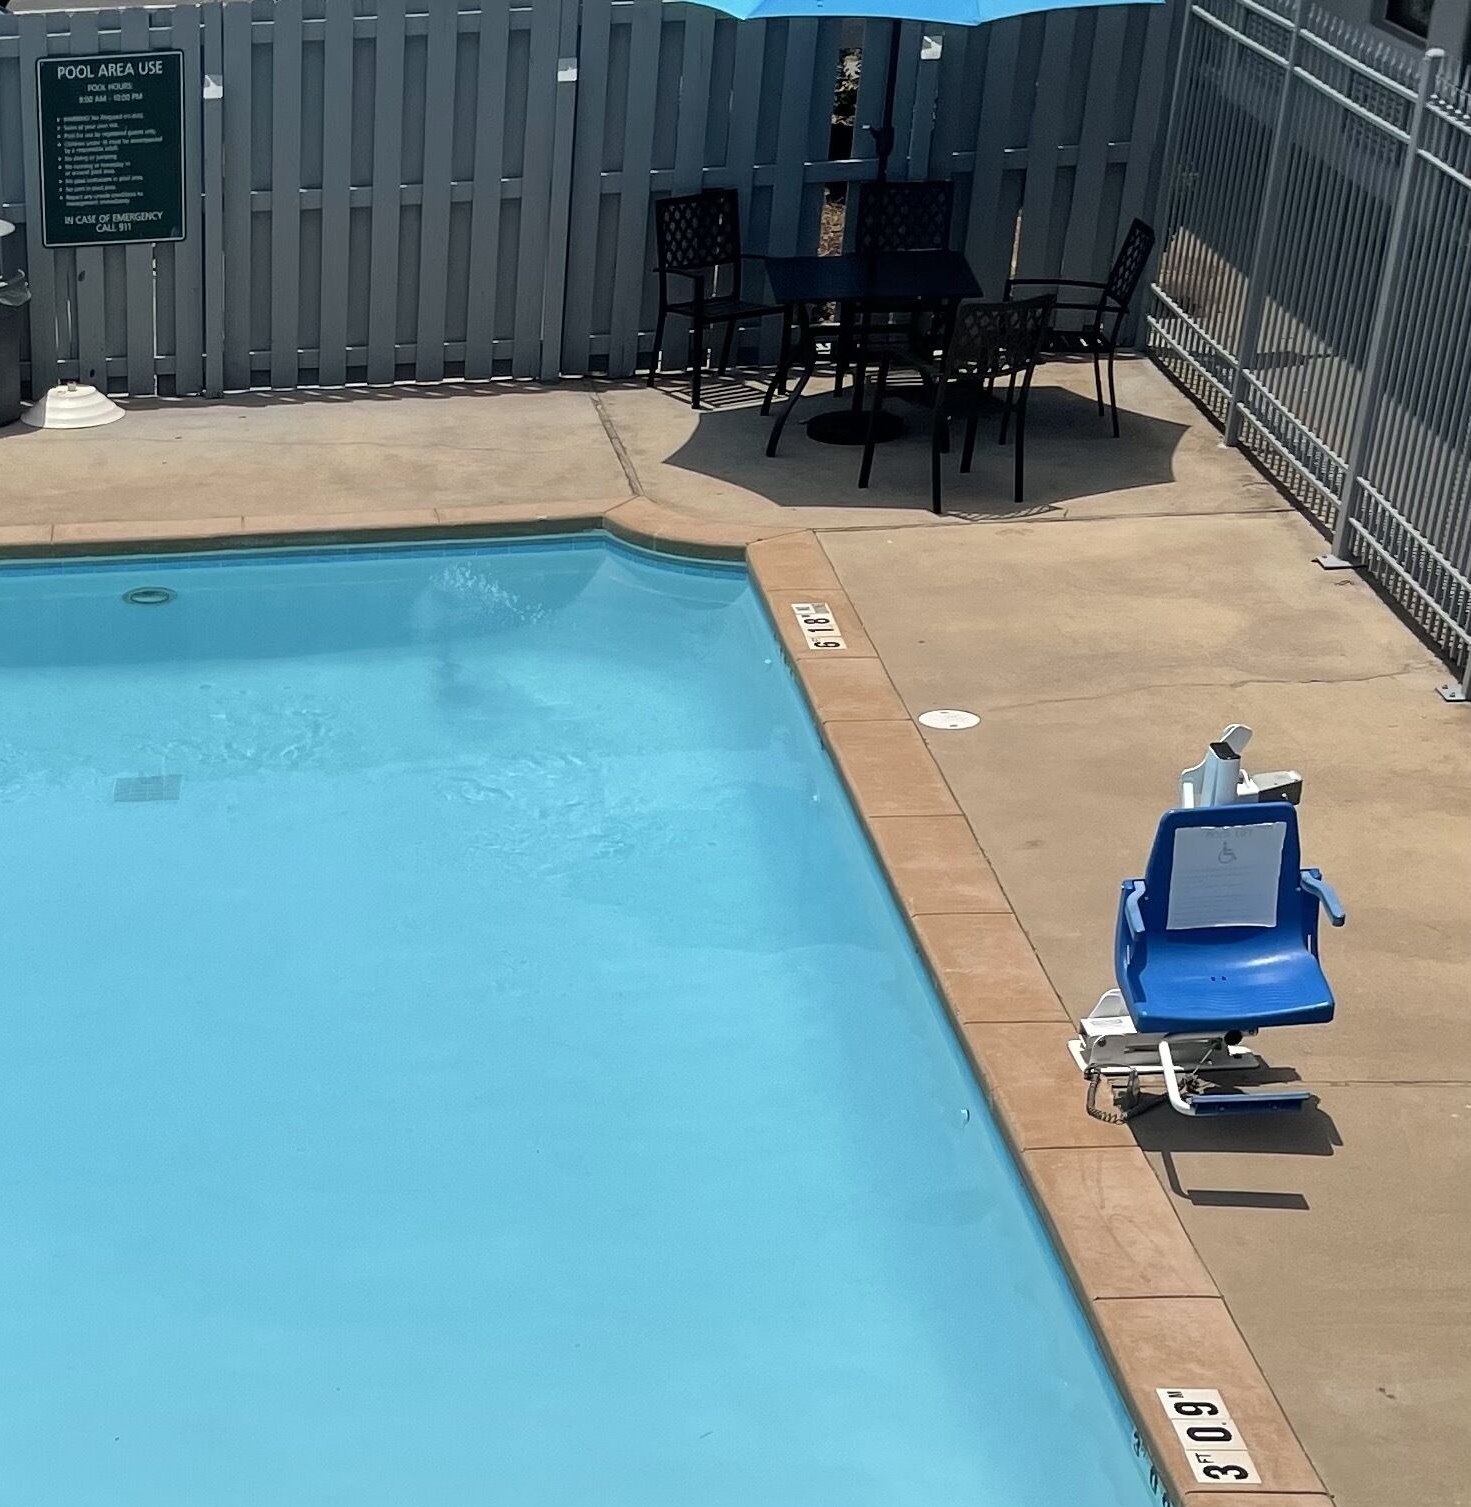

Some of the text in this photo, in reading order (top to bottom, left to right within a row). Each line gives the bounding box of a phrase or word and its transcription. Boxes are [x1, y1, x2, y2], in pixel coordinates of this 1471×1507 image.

[57, 60, 163, 80] POOL AREA USE
[87, 83, 106, 92] POOL
[94, 94, 107, 102] AM
[131, 92, 143, 100] PM
[64, 211, 163, 225] IN CASE OF EMERGENCY
[96, 223, 132, 233] CALL 911
